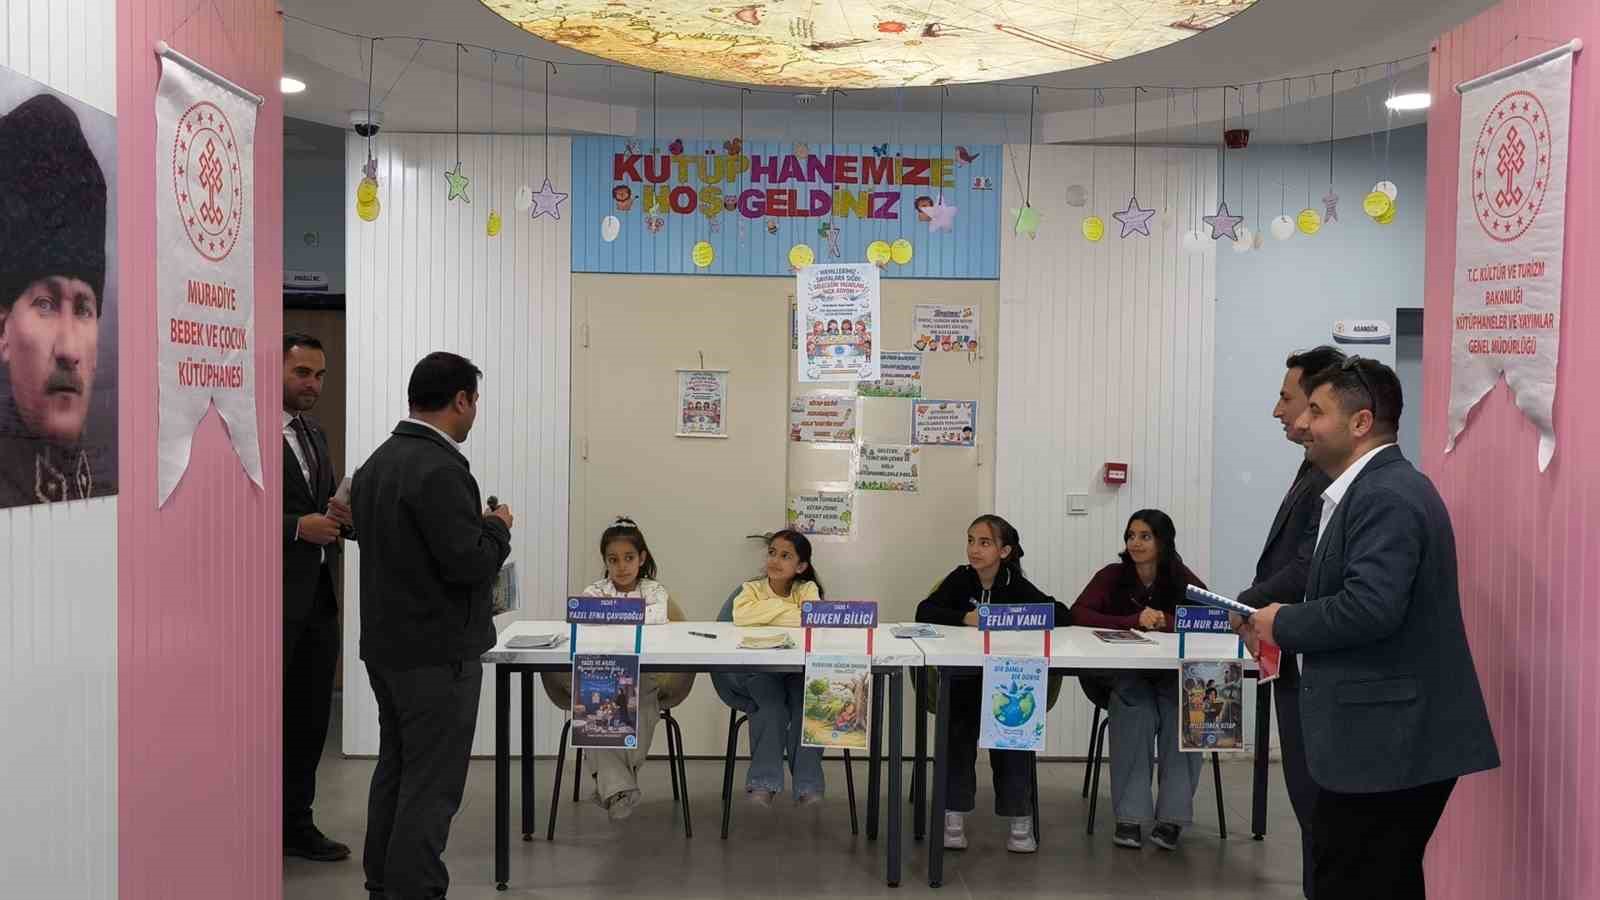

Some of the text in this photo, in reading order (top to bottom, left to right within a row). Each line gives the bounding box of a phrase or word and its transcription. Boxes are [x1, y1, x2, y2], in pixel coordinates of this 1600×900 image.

[613, 150, 956, 188] KÜTÜPHANEMİZE
[642, 185, 901, 220] HOŞ GELDİNİZ
[1480, 264, 1506, 282] KÜLTÜR
[1507, 266, 1516, 280] VE
[1518, 258, 1544, 278] TURİZM
[188, 280, 236, 311] MURADİYE
[1486, 286, 1522, 305] BAKANLIĞI
[1456, 312, 1554, 331] KÜTÜPHANELER VE YAYIMLAR
[170, 318, 247, 356] BEBEK VE ÇOCUK
[1468, 336, 1536, 355] GENEL MÜDÜRLÜĞÜ
[178, 356, 243, 388] KÜTÜPHANESİ
[806, 612, 873, 624] RUKEN BİLİCİ
[987, 612, 1046, 626] EFLİN VANLI
[1177, 619, 1232, 632] ELA NUR BAŞL
